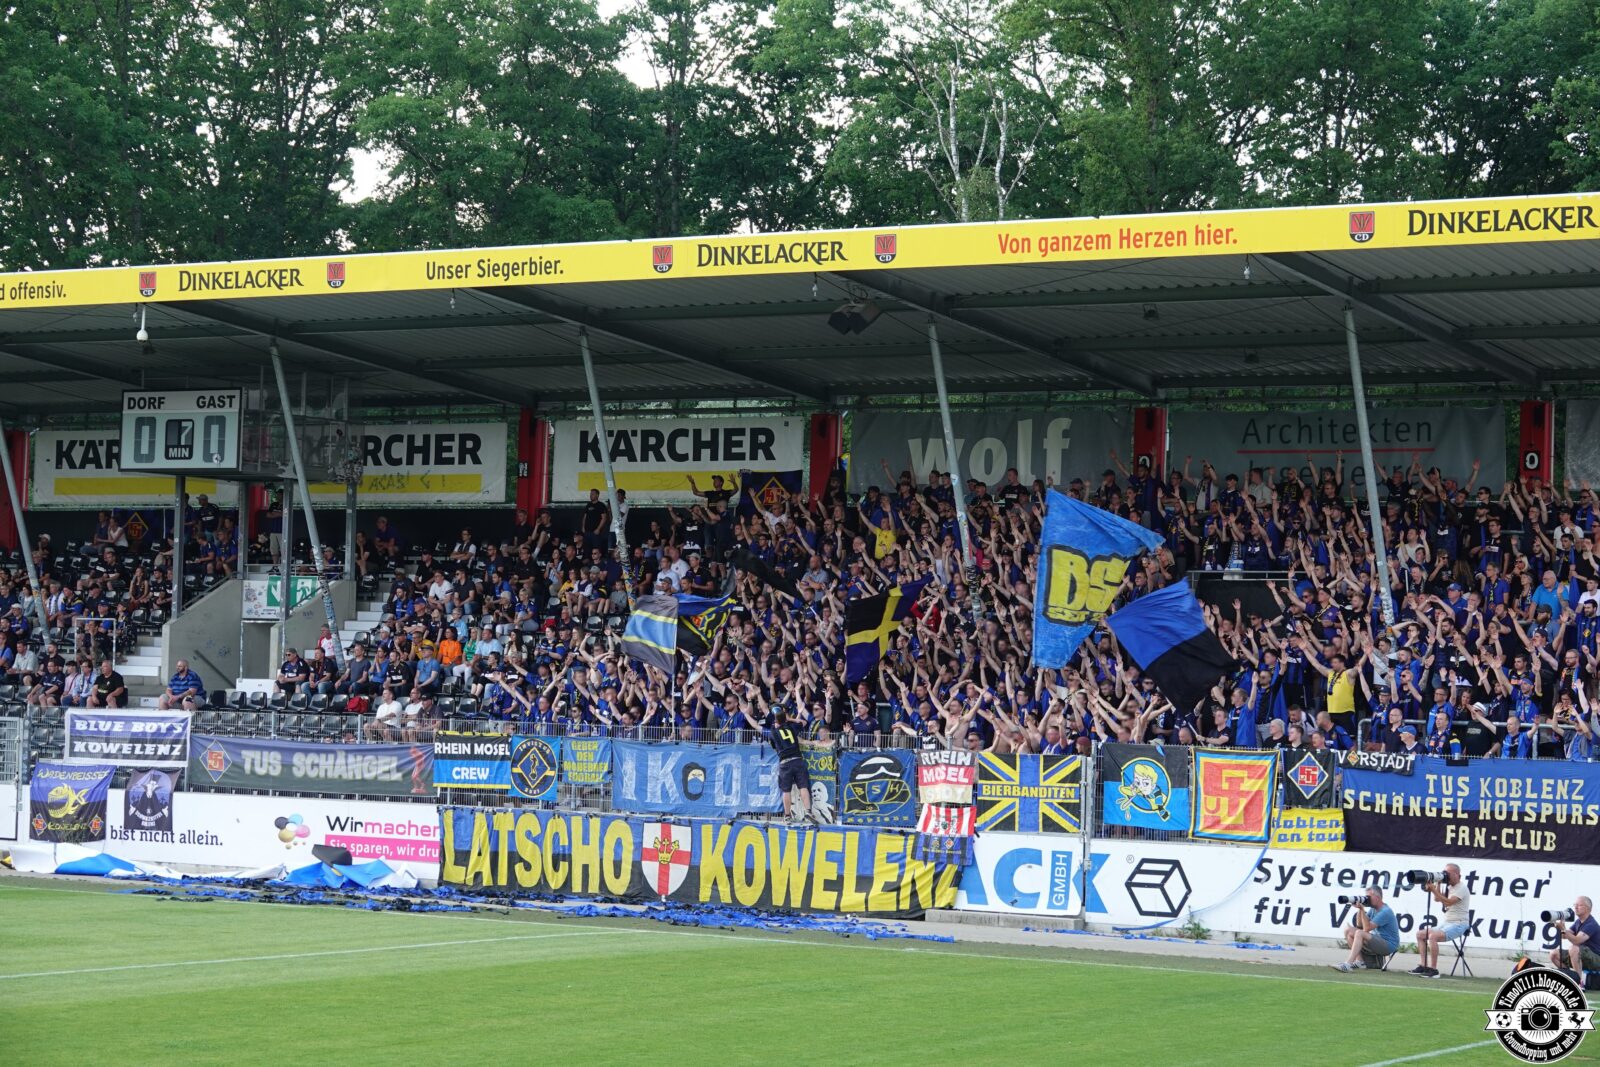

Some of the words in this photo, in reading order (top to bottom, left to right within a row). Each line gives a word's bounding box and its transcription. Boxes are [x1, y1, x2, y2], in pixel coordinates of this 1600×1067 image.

[1407, 204, 1600, 236] DINKELACKER
[998, 232, 1031, 255] Von
[1038, 233, 1112, 258] ganzem
[1119, 226, 1187, 250] Herzen
[1195, 223, 1238, 247] hier.
[697, 241, 848, 267] DINKELACKER
[179, 268, 304, 293] DINKELACKER
[426, 260, 471, 281] Unser
[477, 255, 564, 282] Siegerbier.
[10, 280, 67, 300] offensiv.
[127, 396, 166, 410] DORF
[196, 395, 236, 409] GAST
[133, 416, 157, 464] 0
[180, 420, 194, 446] 7
[168, 447, 190, 458] MIN
[578, 426, 776, 464] KÄRCHER
[908, 417, 1073, 486] wolf
[74, 719, 126, 732] BLUE
[130, 721, 183, 734] BOYS
[778, 728, 795, 744] 4
[73, 741, 182, 756] KOWELENZ
[434, 741, 474, 756] RHEIN
[477, 742, 511, 757] MOSEL
[921, 750, 972, 766] RHEIN
[1337, 750, 1414, 771] VRSTADT
[241, 750, 282, 776] TUS
[292, 749, 403, 782] SCHÄNGEL
[452, 766, 490, 780] CREW
[922, 766, 969, 783] MOSEL
[982, 784, 1075, 799] BIERBANDITEN
[1426, 774, 1470, 797] TUS
[1480, 777, 1585, 801] KOBLENZ
[1343, 788, 1469, 819] SCHÄNGEL
[1479, 800, 1599, 826] HOTSPURS
[1272, 816, 1344, 829] oblen
[110, 825, 136, 841] bist
[139, 830, 175, 844] nicht
[179, 829, 223, 846] allein.
[1445, 825, 1557, 851] FAN-CLUB
[351, 842, 393, 857] sparen,
[396, 843, 415, 856] wir
[443, 809, 634, 896] LATSCHO
[698, 823, 960, 912] KOWELENZ
[1052, 853, 1068, 906] GMBH
[1253, 857, 1553, 899] Systemptner
[1254, 896, 1311, 926] für
[1329, 902, 1562, 949] Vpakung
